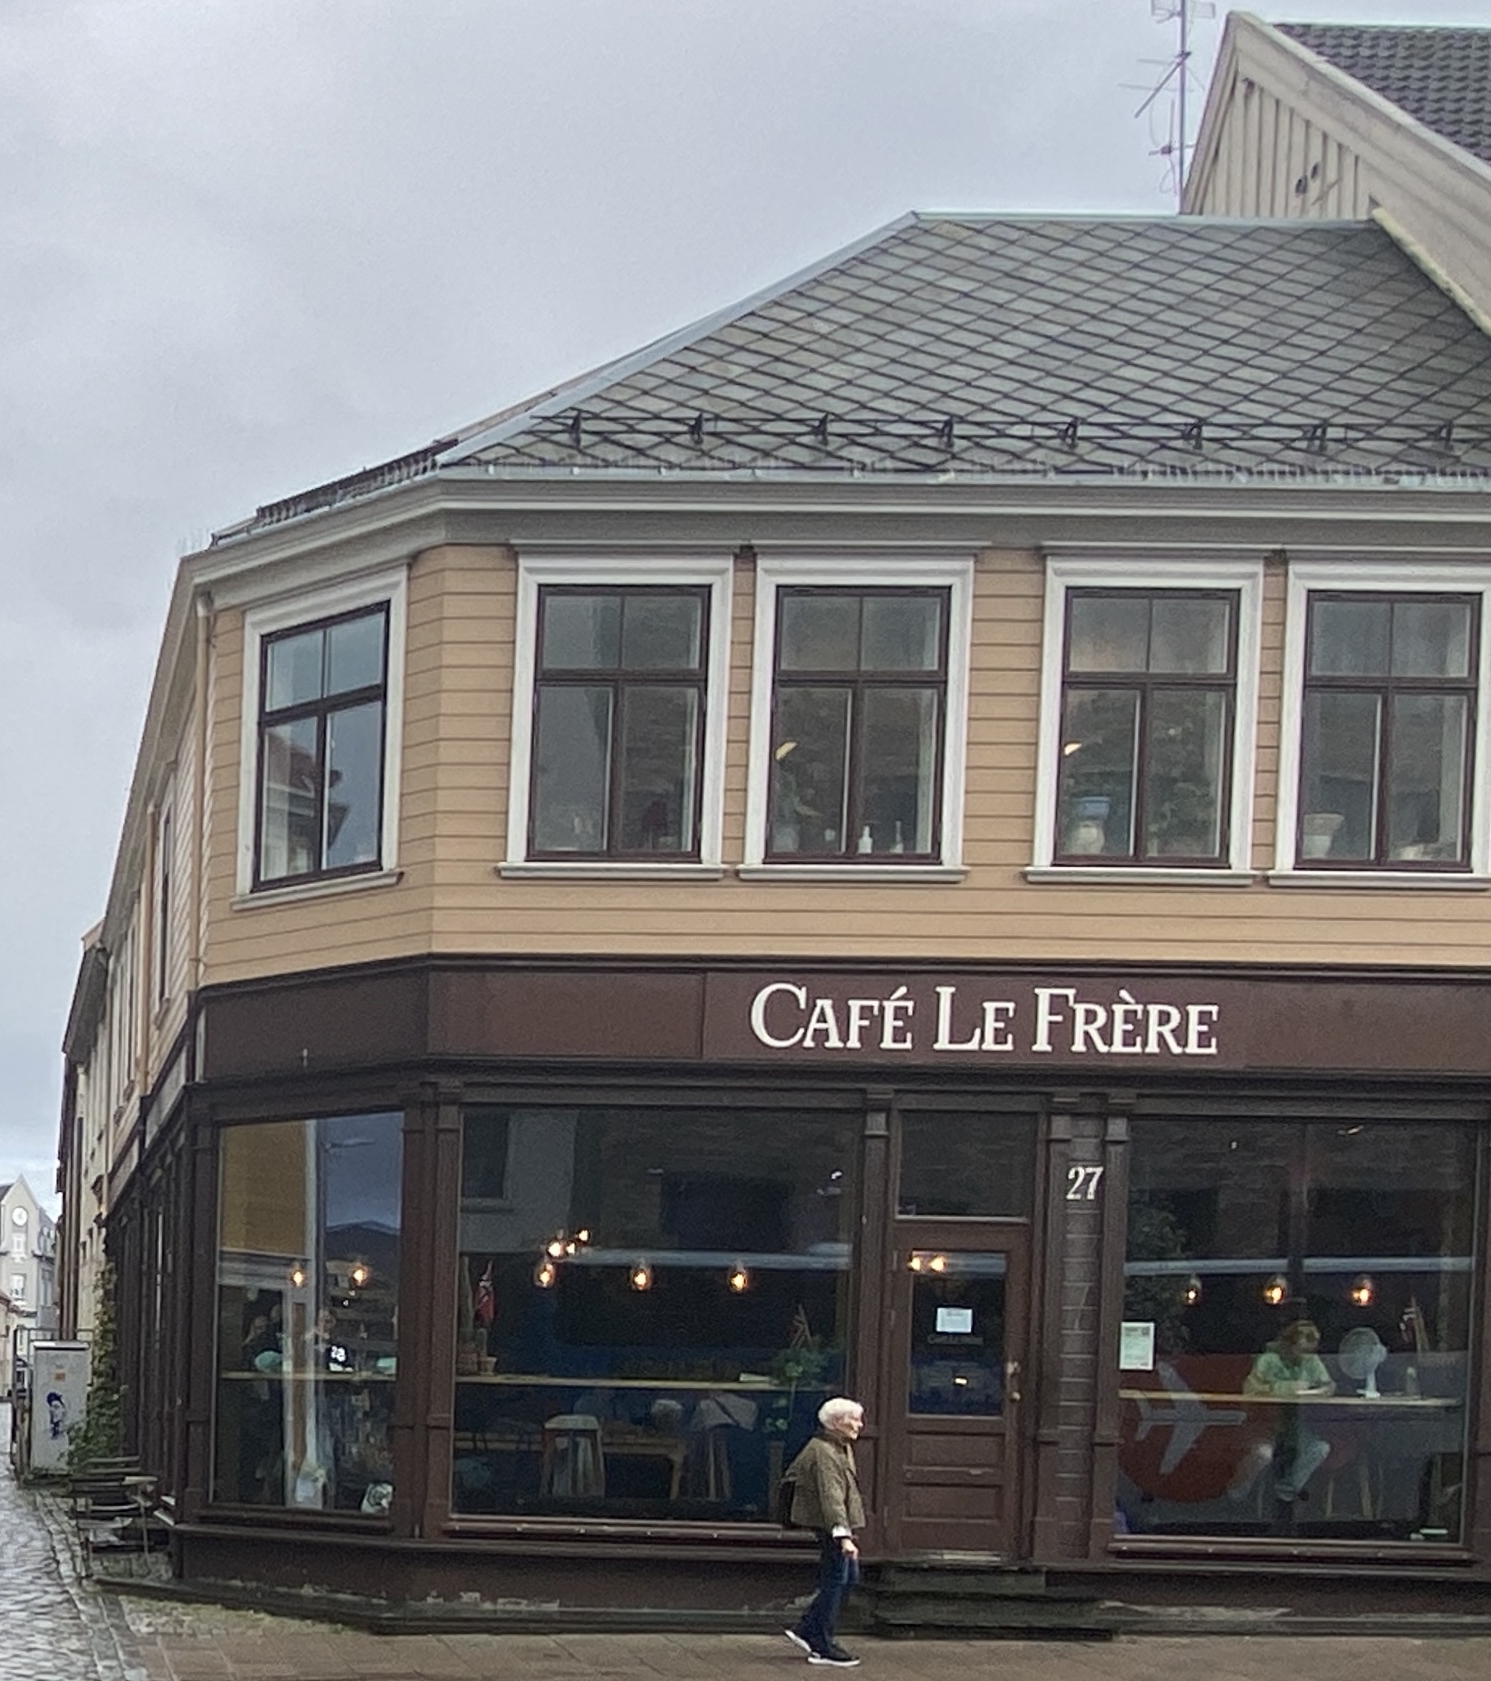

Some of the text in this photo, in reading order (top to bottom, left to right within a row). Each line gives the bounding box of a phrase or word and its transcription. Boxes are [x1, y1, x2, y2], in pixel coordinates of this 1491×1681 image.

[750, 982, 1219, 1055] CAFÉ LE FRÈRE
[1065, 1165, 1104, 1201] 27
